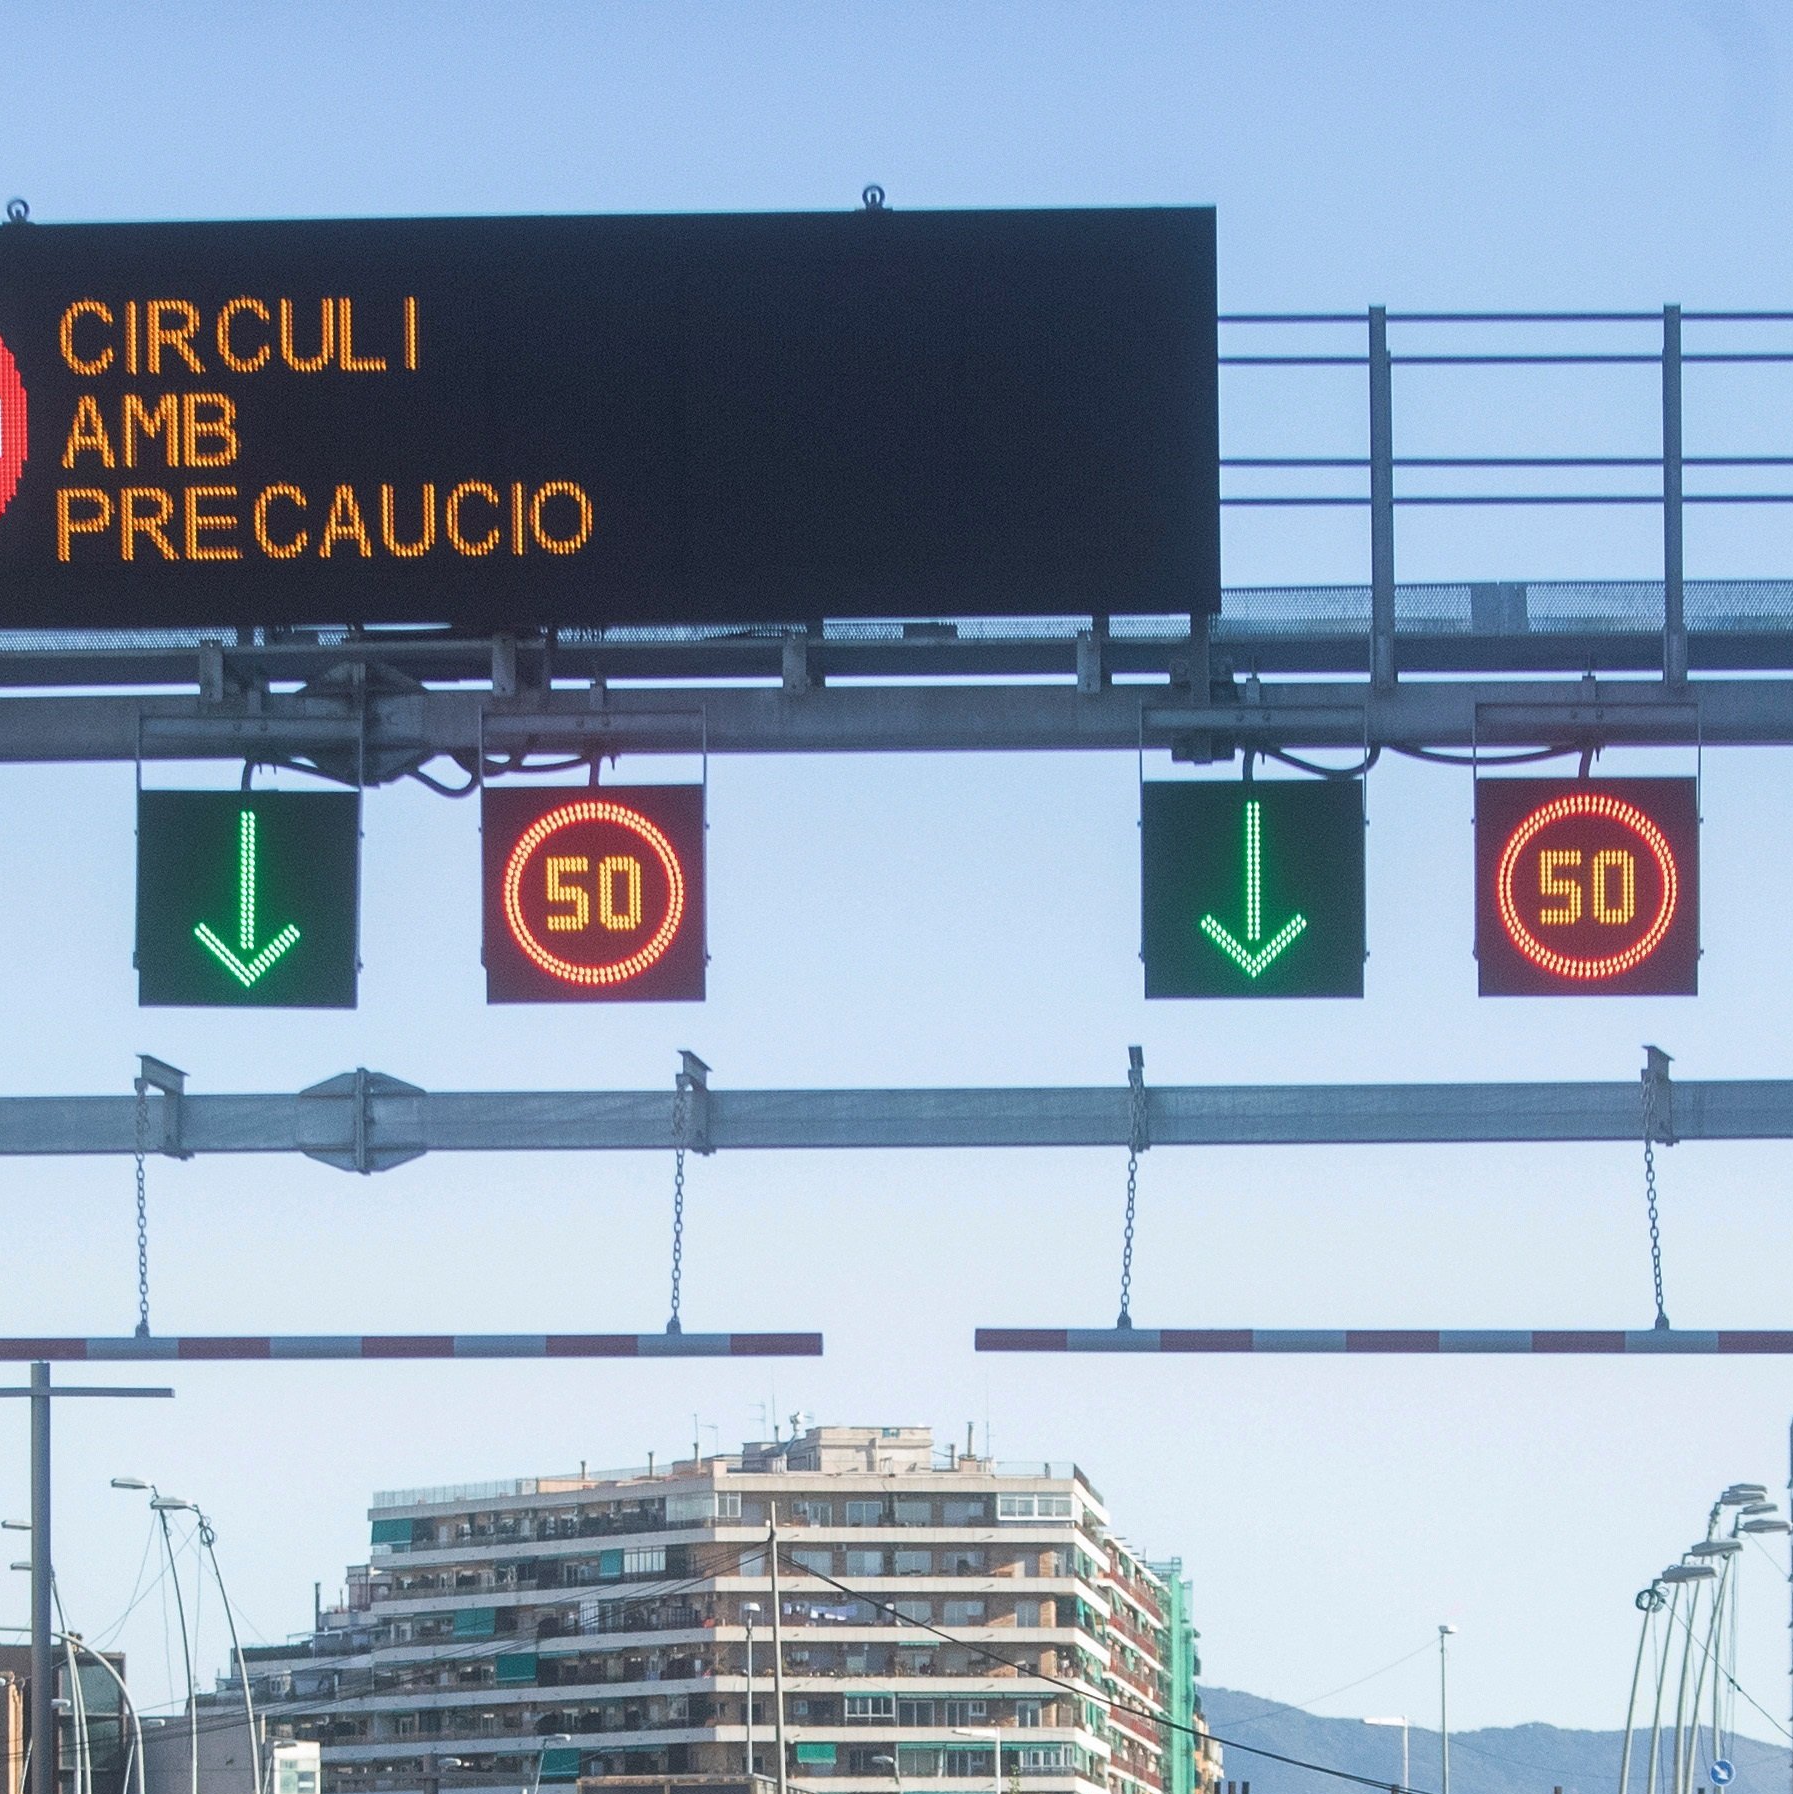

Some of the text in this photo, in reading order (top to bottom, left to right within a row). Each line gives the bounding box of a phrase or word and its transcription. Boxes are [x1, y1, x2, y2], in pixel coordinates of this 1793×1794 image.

[60, 297, 416, 375] CIRCULI
[61, 394, 239, 469] AMB
[56, 481, 594, 562] PRECAUCIO
[546, 856, 642, 933] 50
[1540, 849, 1635, 925] 50
